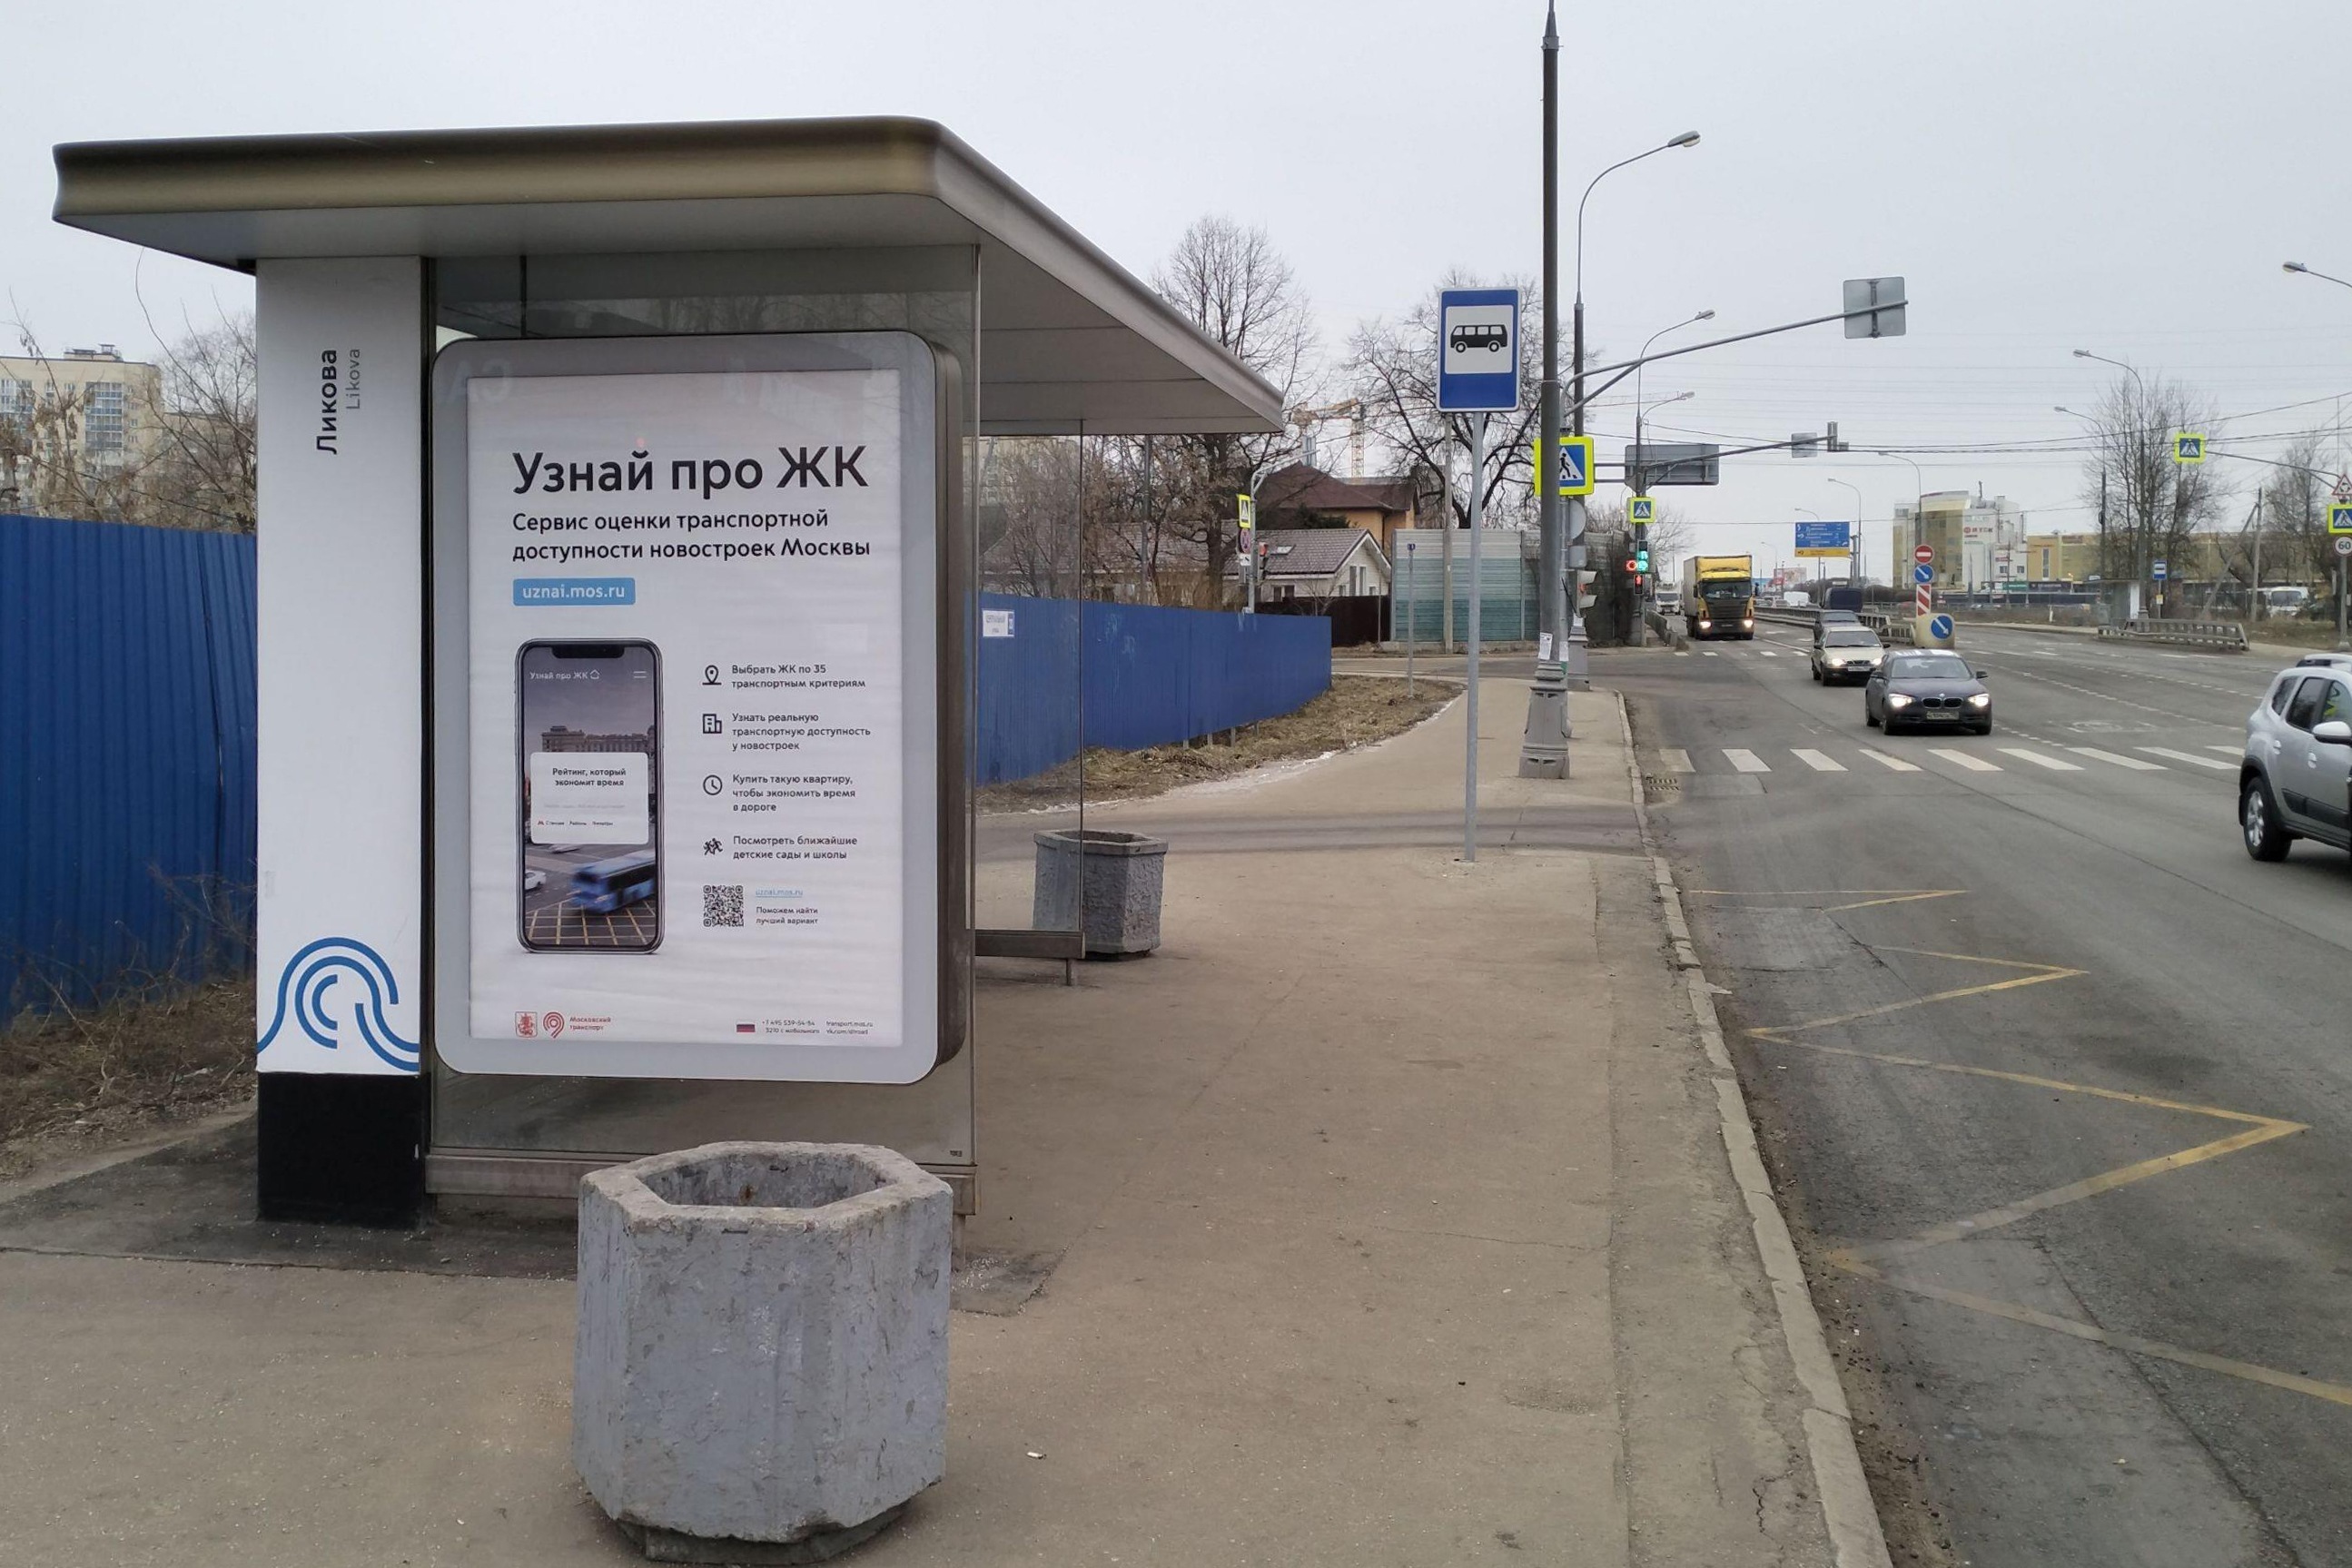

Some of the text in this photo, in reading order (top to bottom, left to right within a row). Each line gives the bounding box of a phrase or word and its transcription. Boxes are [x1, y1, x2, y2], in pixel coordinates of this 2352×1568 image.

[345, 349, 361, 409] Likova
[316, 350, 337, 455] Ликова
[512, 446, 869, 500] Узнай про ЖК
[513, 508, 828, 534] Сервис оценки транспортной
[513, 538, 870, 563] доступности новостроек Москвы
[2337, 541, 2351, 550] 60
[522, 584, 626, 599] uznai.mos.ru
[529, 671, 554, 679] Узнай
[573, 671, 588, 679] ЖК
[732, 665, 776, 676] Выбрать
[778, 665, 796, 674] ЖК
[814, 665, 826, 674] 35
[732, 680, 865, 689] транспортным критериям
[732, 713, 818, 724] Узнать реальную
[732, 728, 871, 737] транспортную доступность
[732, 742, 799, 751] у новостроек
[552, 767, 627, 776] Рейтинг, который
[732, 774, 853, 785] Купить такую квартиру,
[732, 789, 764, 797] чтобы
[824, 790, 855, 799] время
[741, 804, 776, 814] дороге
[733, 835, 857, 846] Посмотреть ближайшие
[733, 851, 773, 860] детские
[776, 851, 801, 860] сады
[756, 906, 794, 914] Поможем
[756, 917, 785, 925] лучший
